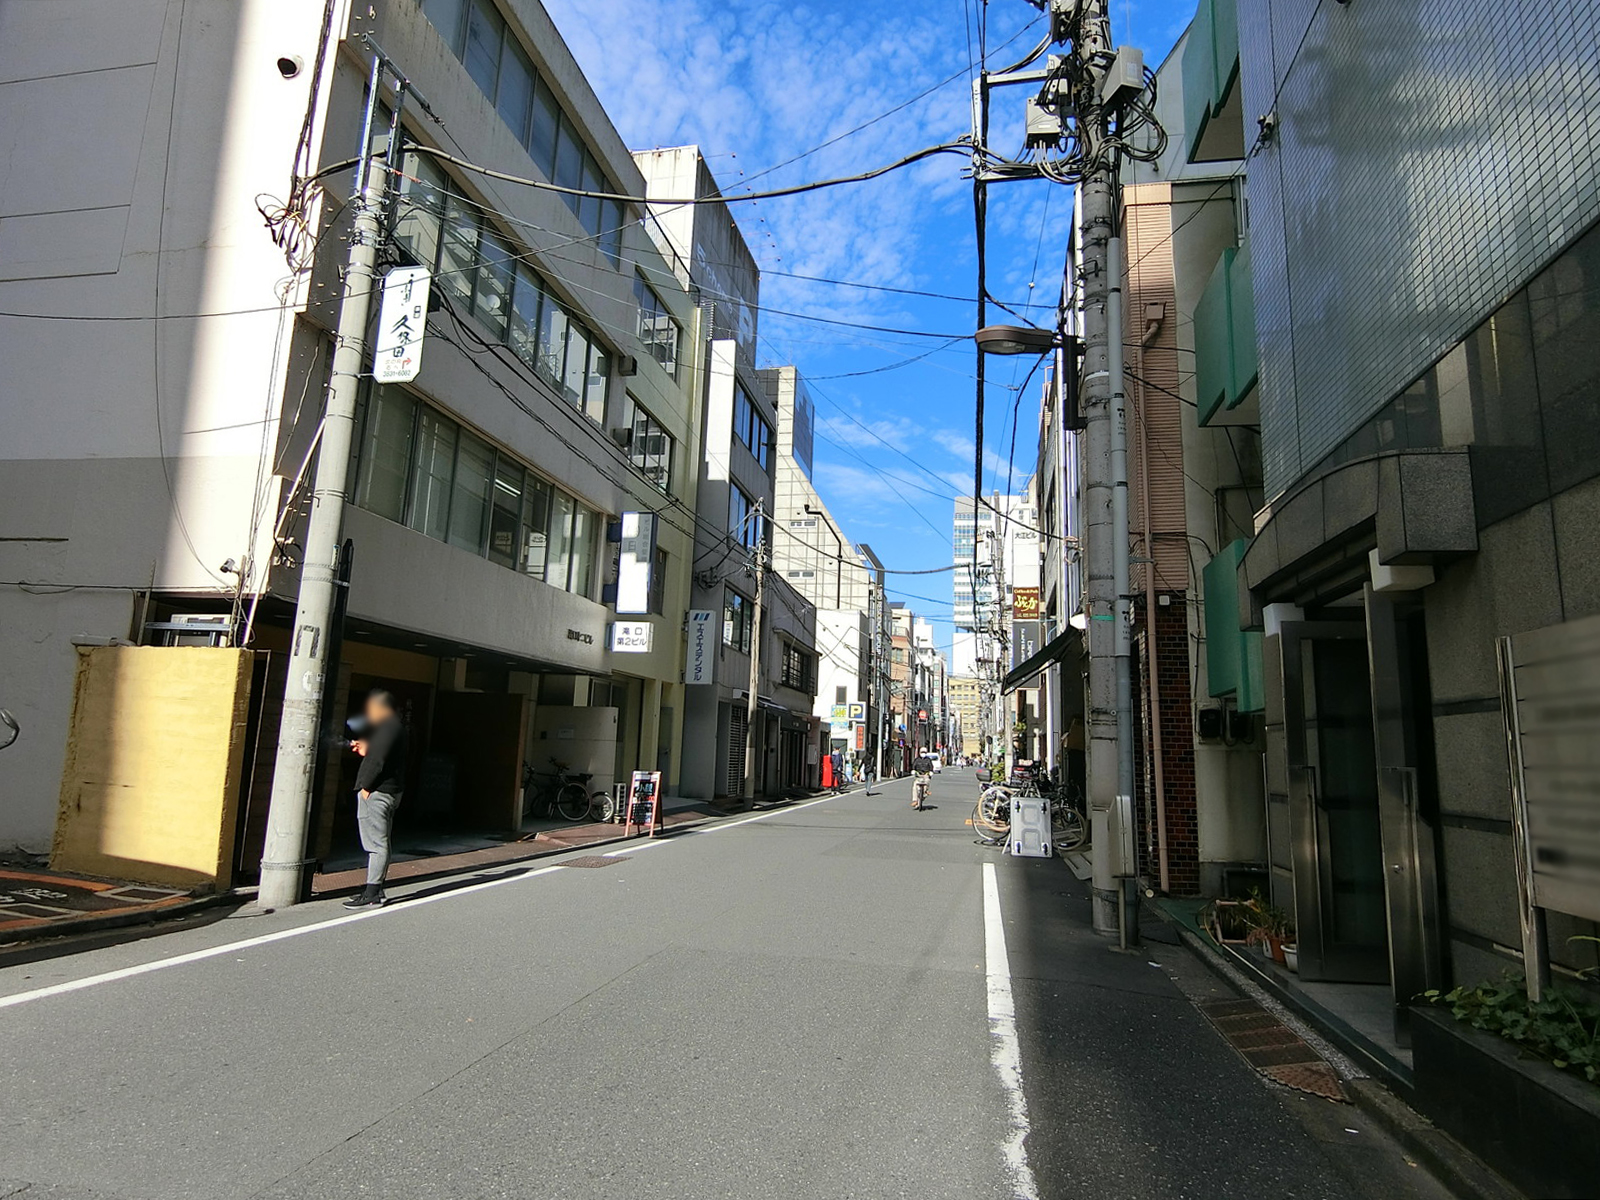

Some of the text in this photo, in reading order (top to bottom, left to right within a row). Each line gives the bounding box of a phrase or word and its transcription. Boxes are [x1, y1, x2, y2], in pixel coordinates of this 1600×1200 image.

[617, 637, 647, 646] 第2ビル
[850, 705, 862, 718] P
